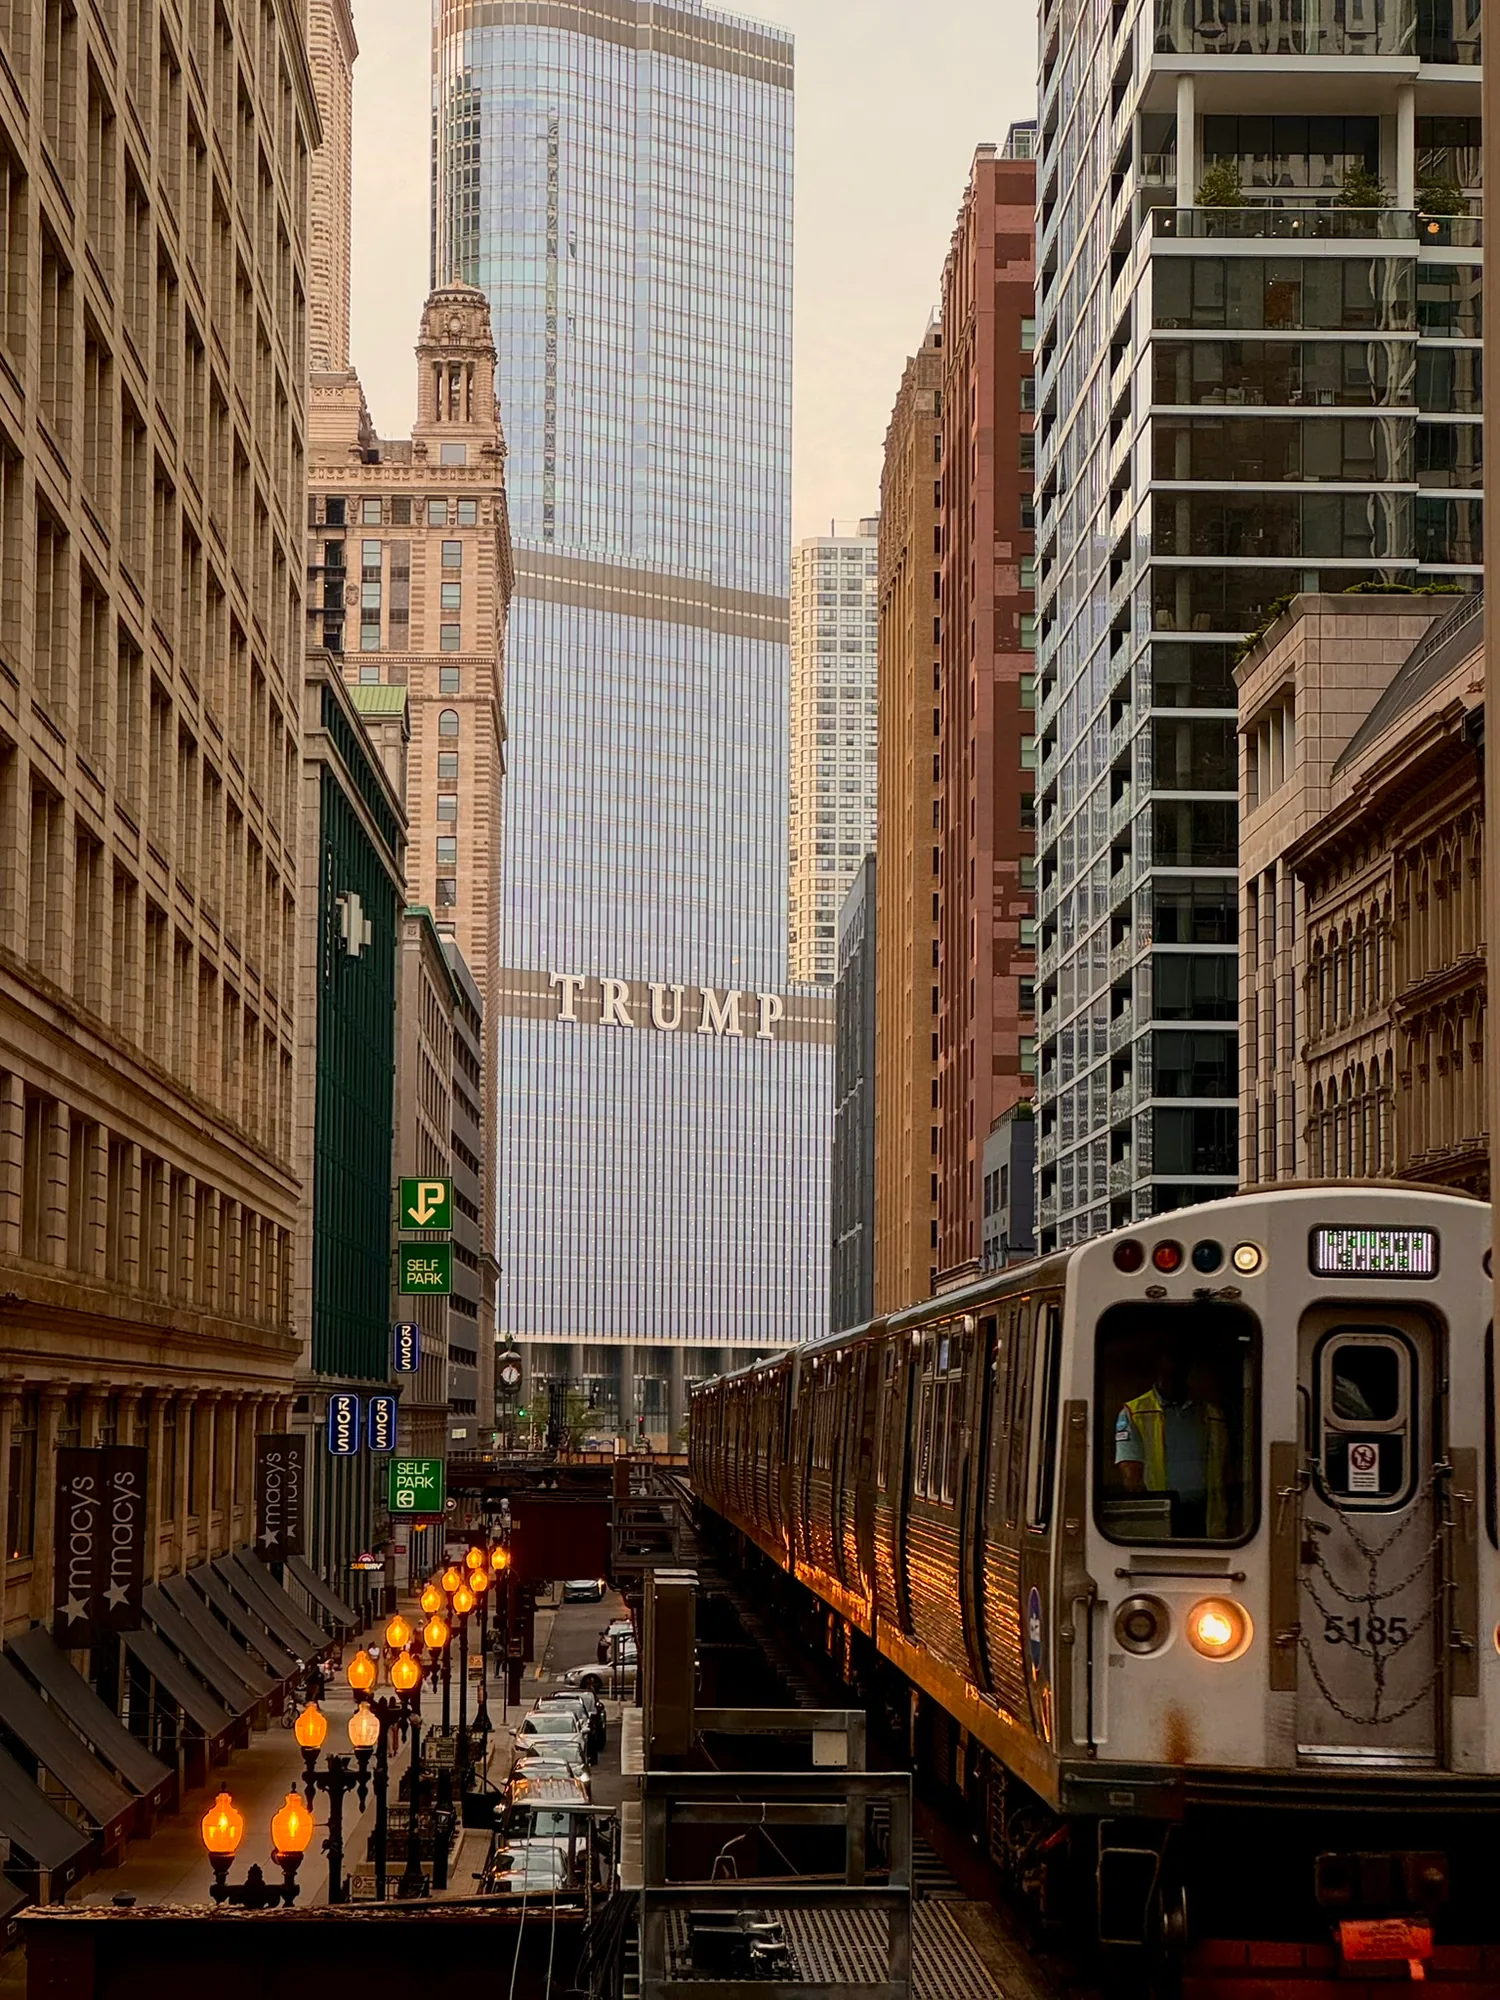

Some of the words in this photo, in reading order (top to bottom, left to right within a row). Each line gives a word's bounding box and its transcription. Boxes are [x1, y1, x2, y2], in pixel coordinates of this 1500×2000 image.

[549, 972, 783, 1040] TRUMP
[416, 1182, 446, 1226] P
[406, 1273, 443, 1285] PARK
[407, 1260, 439, 1272] SELF
[400, 1325, 412, 1370] ROSS
[337, 1397, 351, 1452] ROSS
[376, 1399, 388, 1448] ROSS
[396, 1462, 430, 1475] SELF
[396, 1476, 434, 1489] PARK
[351, 1562, 383, 1570] SUBWAY
[1324, 1615, 1408, 1645] 5185
